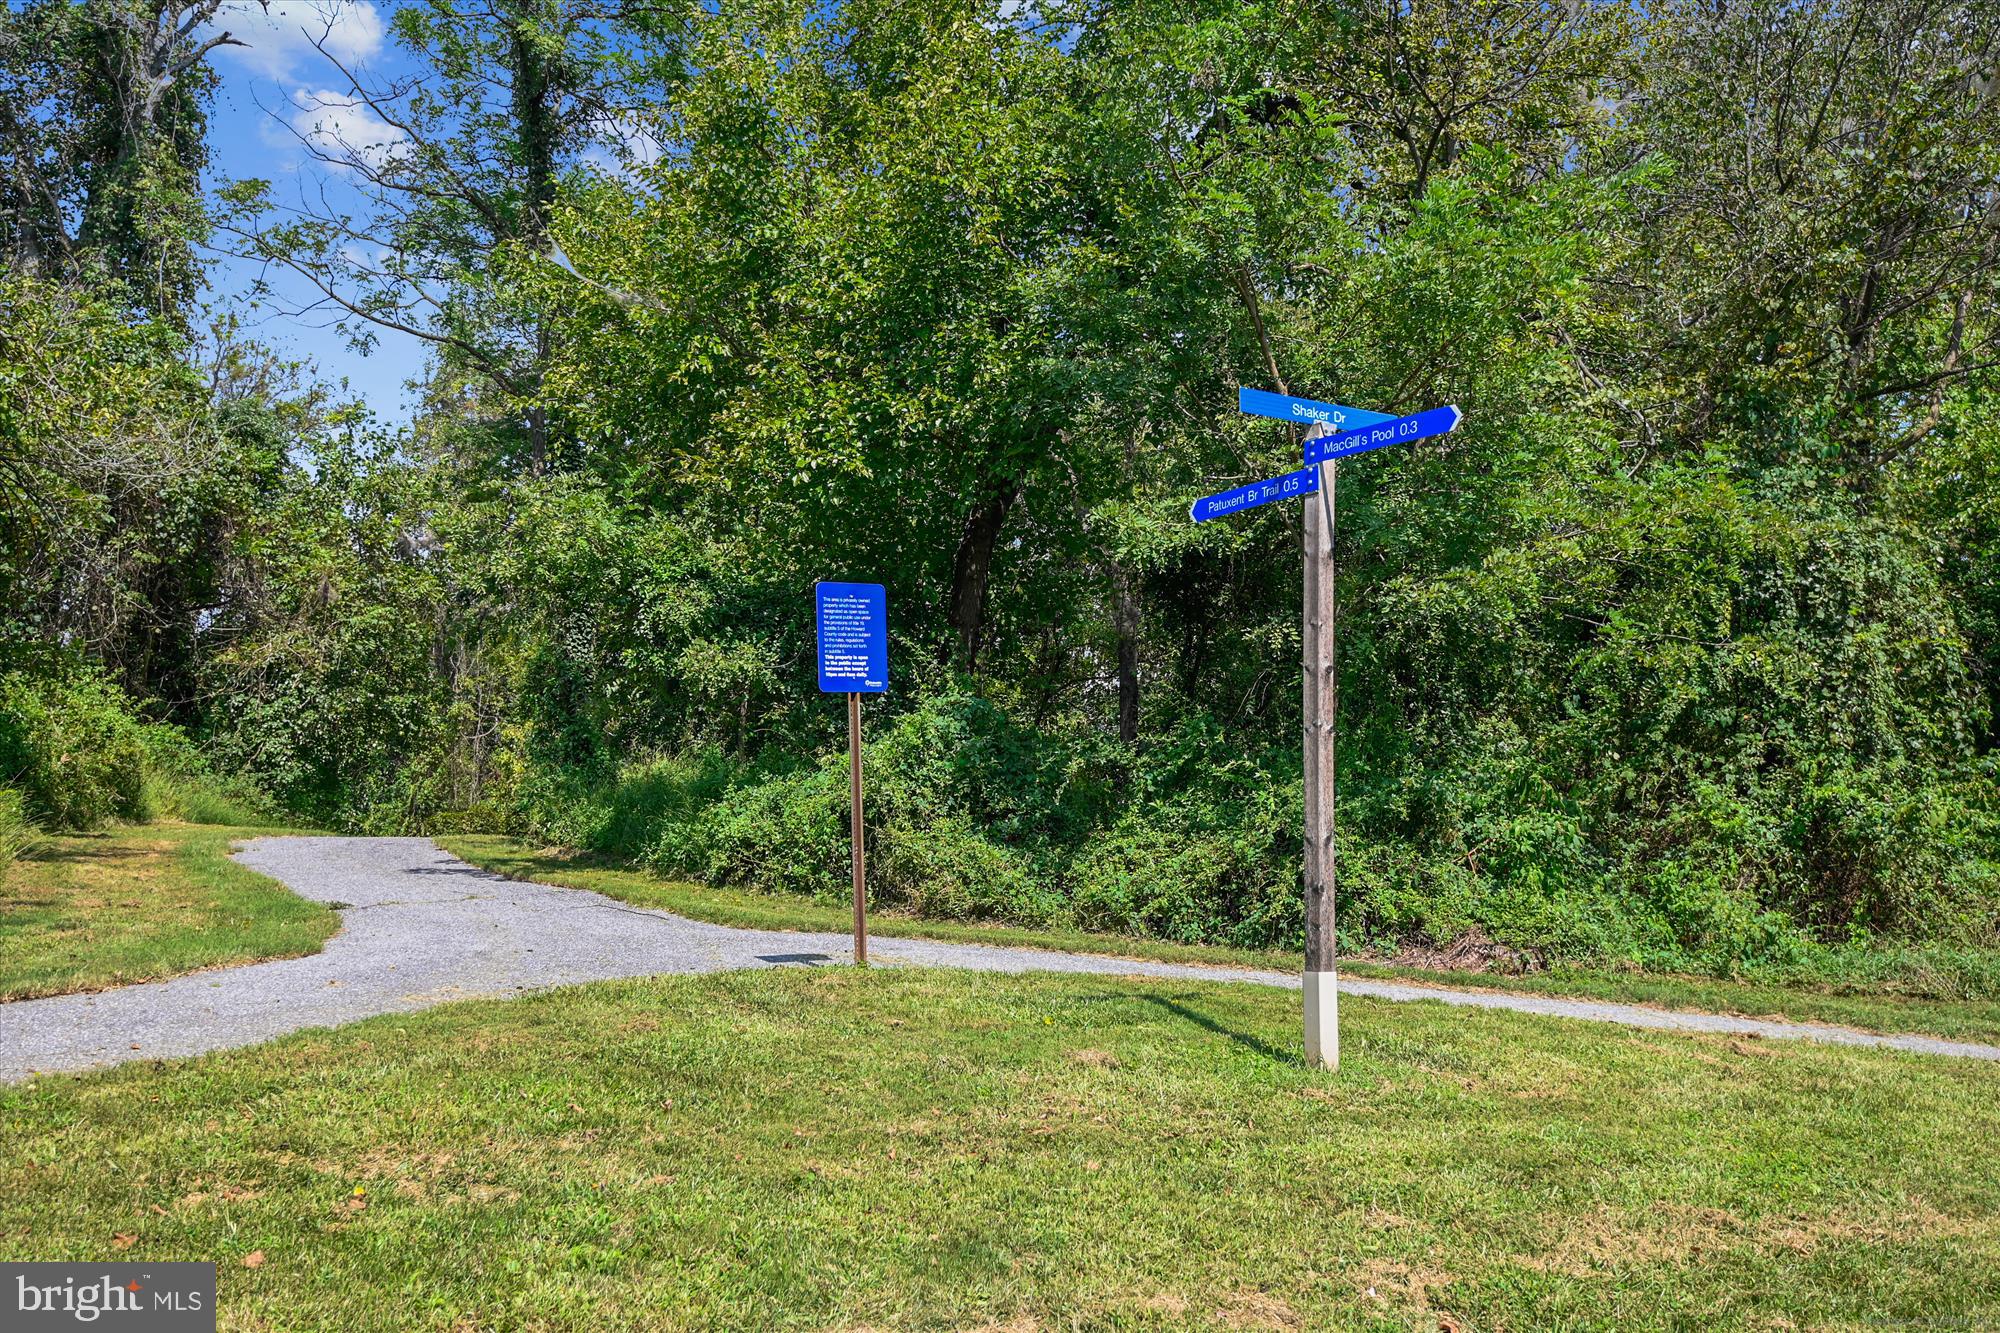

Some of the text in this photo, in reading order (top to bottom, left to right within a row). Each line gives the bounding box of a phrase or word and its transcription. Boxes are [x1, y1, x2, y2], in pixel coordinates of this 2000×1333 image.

[1292, 403, 1347, 423] Shaker Dr
[1323, 420, 1418, 454] MacGill's Pool 0.3
[1208, 477, 1299, 513] Patuxent Br Trail 0.5
